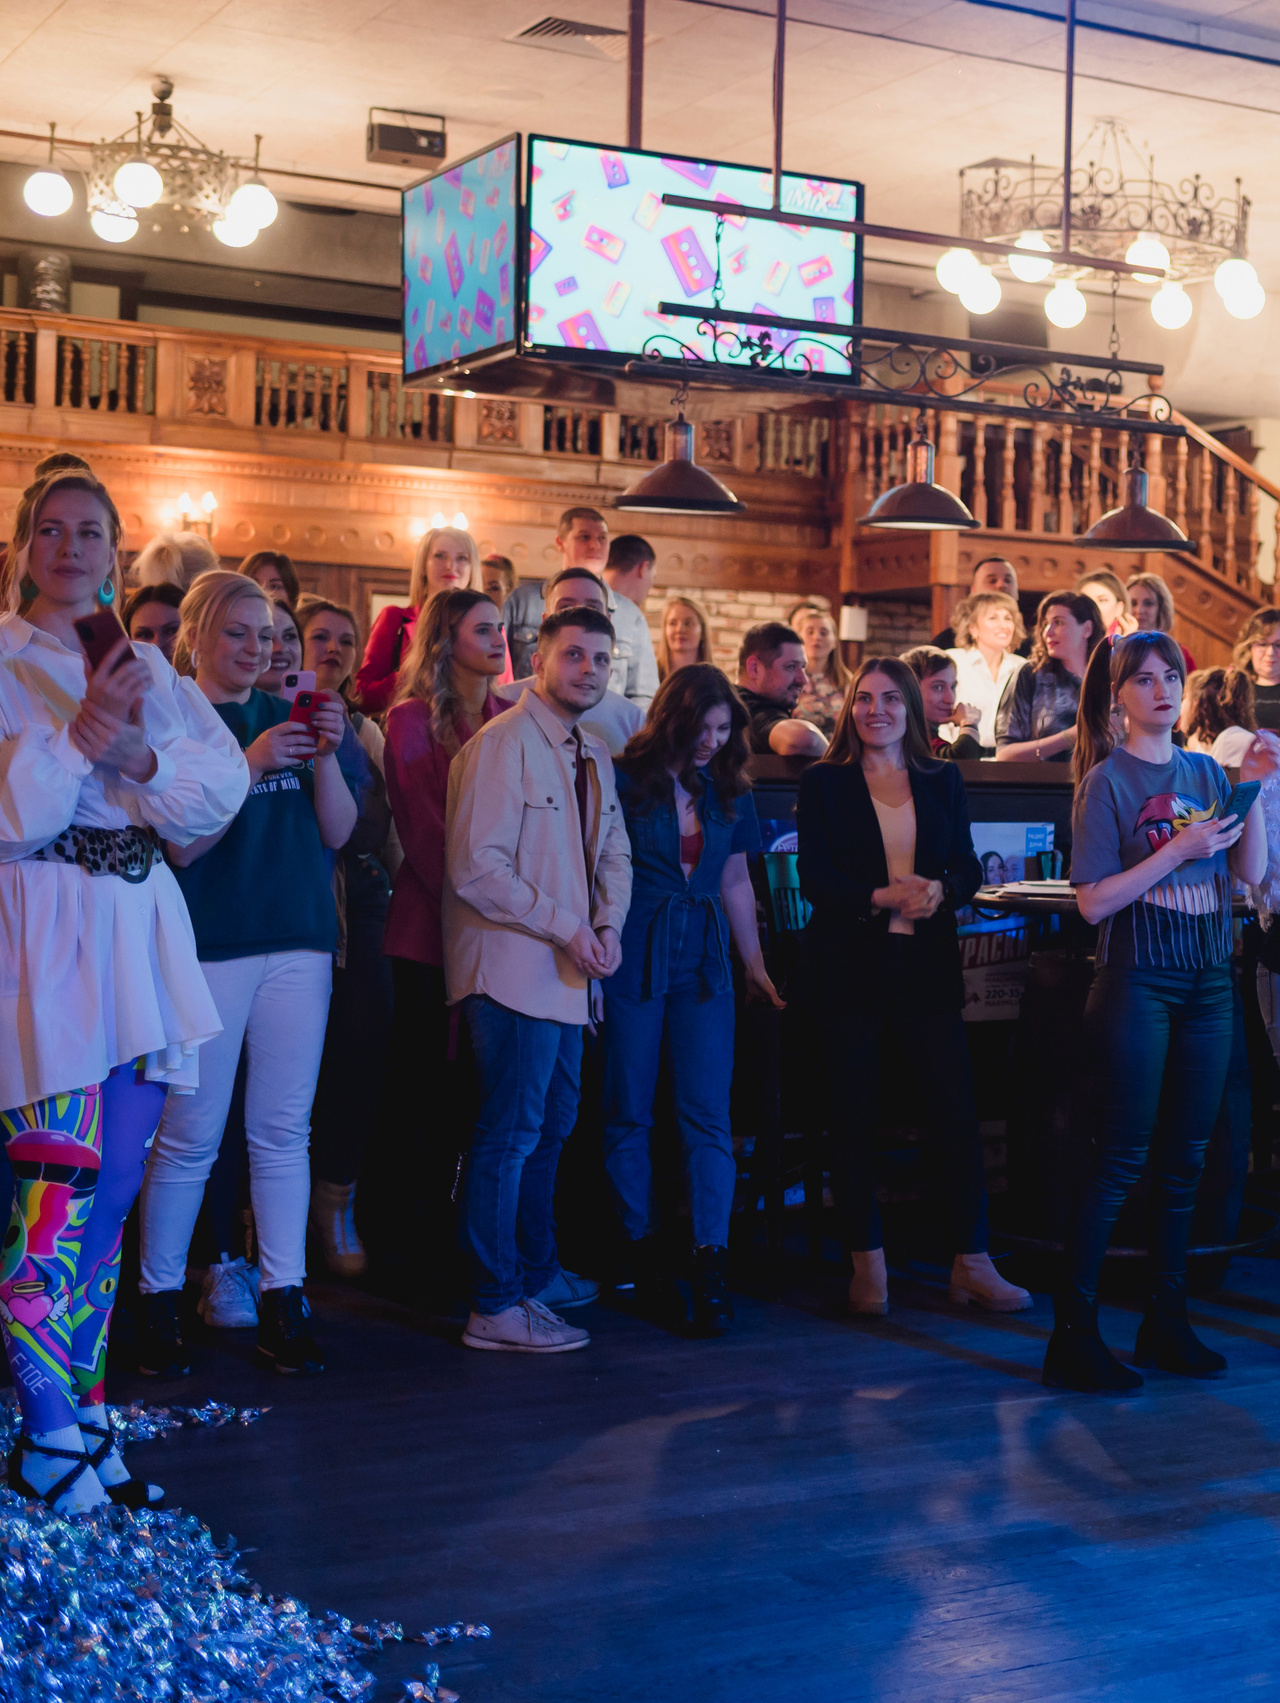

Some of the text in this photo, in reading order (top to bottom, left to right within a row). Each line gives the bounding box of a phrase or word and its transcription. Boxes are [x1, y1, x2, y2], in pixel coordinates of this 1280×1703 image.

[250, 776, 301, 795] ATE OF MIND
